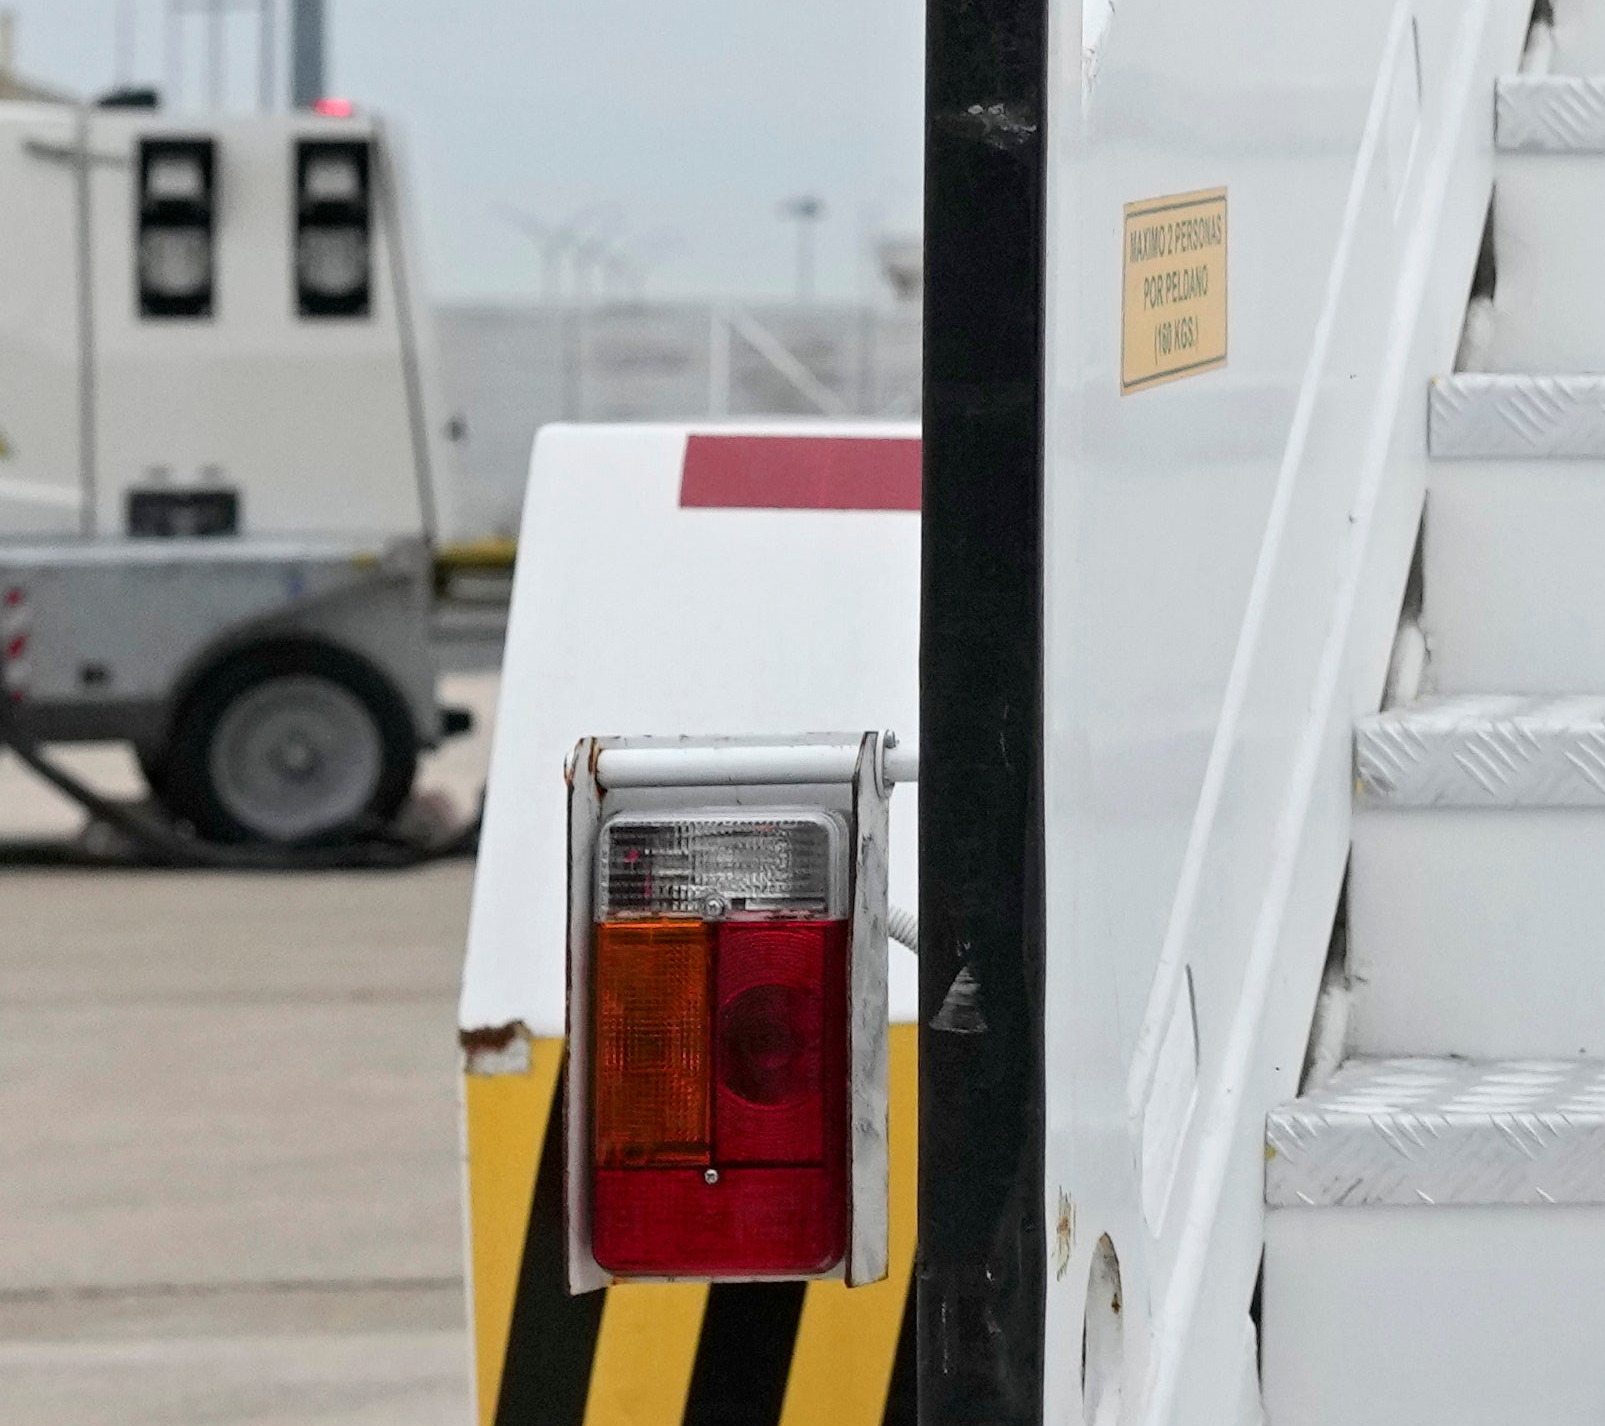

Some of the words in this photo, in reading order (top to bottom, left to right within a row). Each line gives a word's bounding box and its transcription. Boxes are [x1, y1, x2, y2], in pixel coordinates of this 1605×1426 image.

[1129, 226, 1166, 263] MAXIMO
[1167, 225, 1174, 256] 2
[1174, 213, 1222, 255] PERSONAS
[1143, 273, 1163, 310] POR
